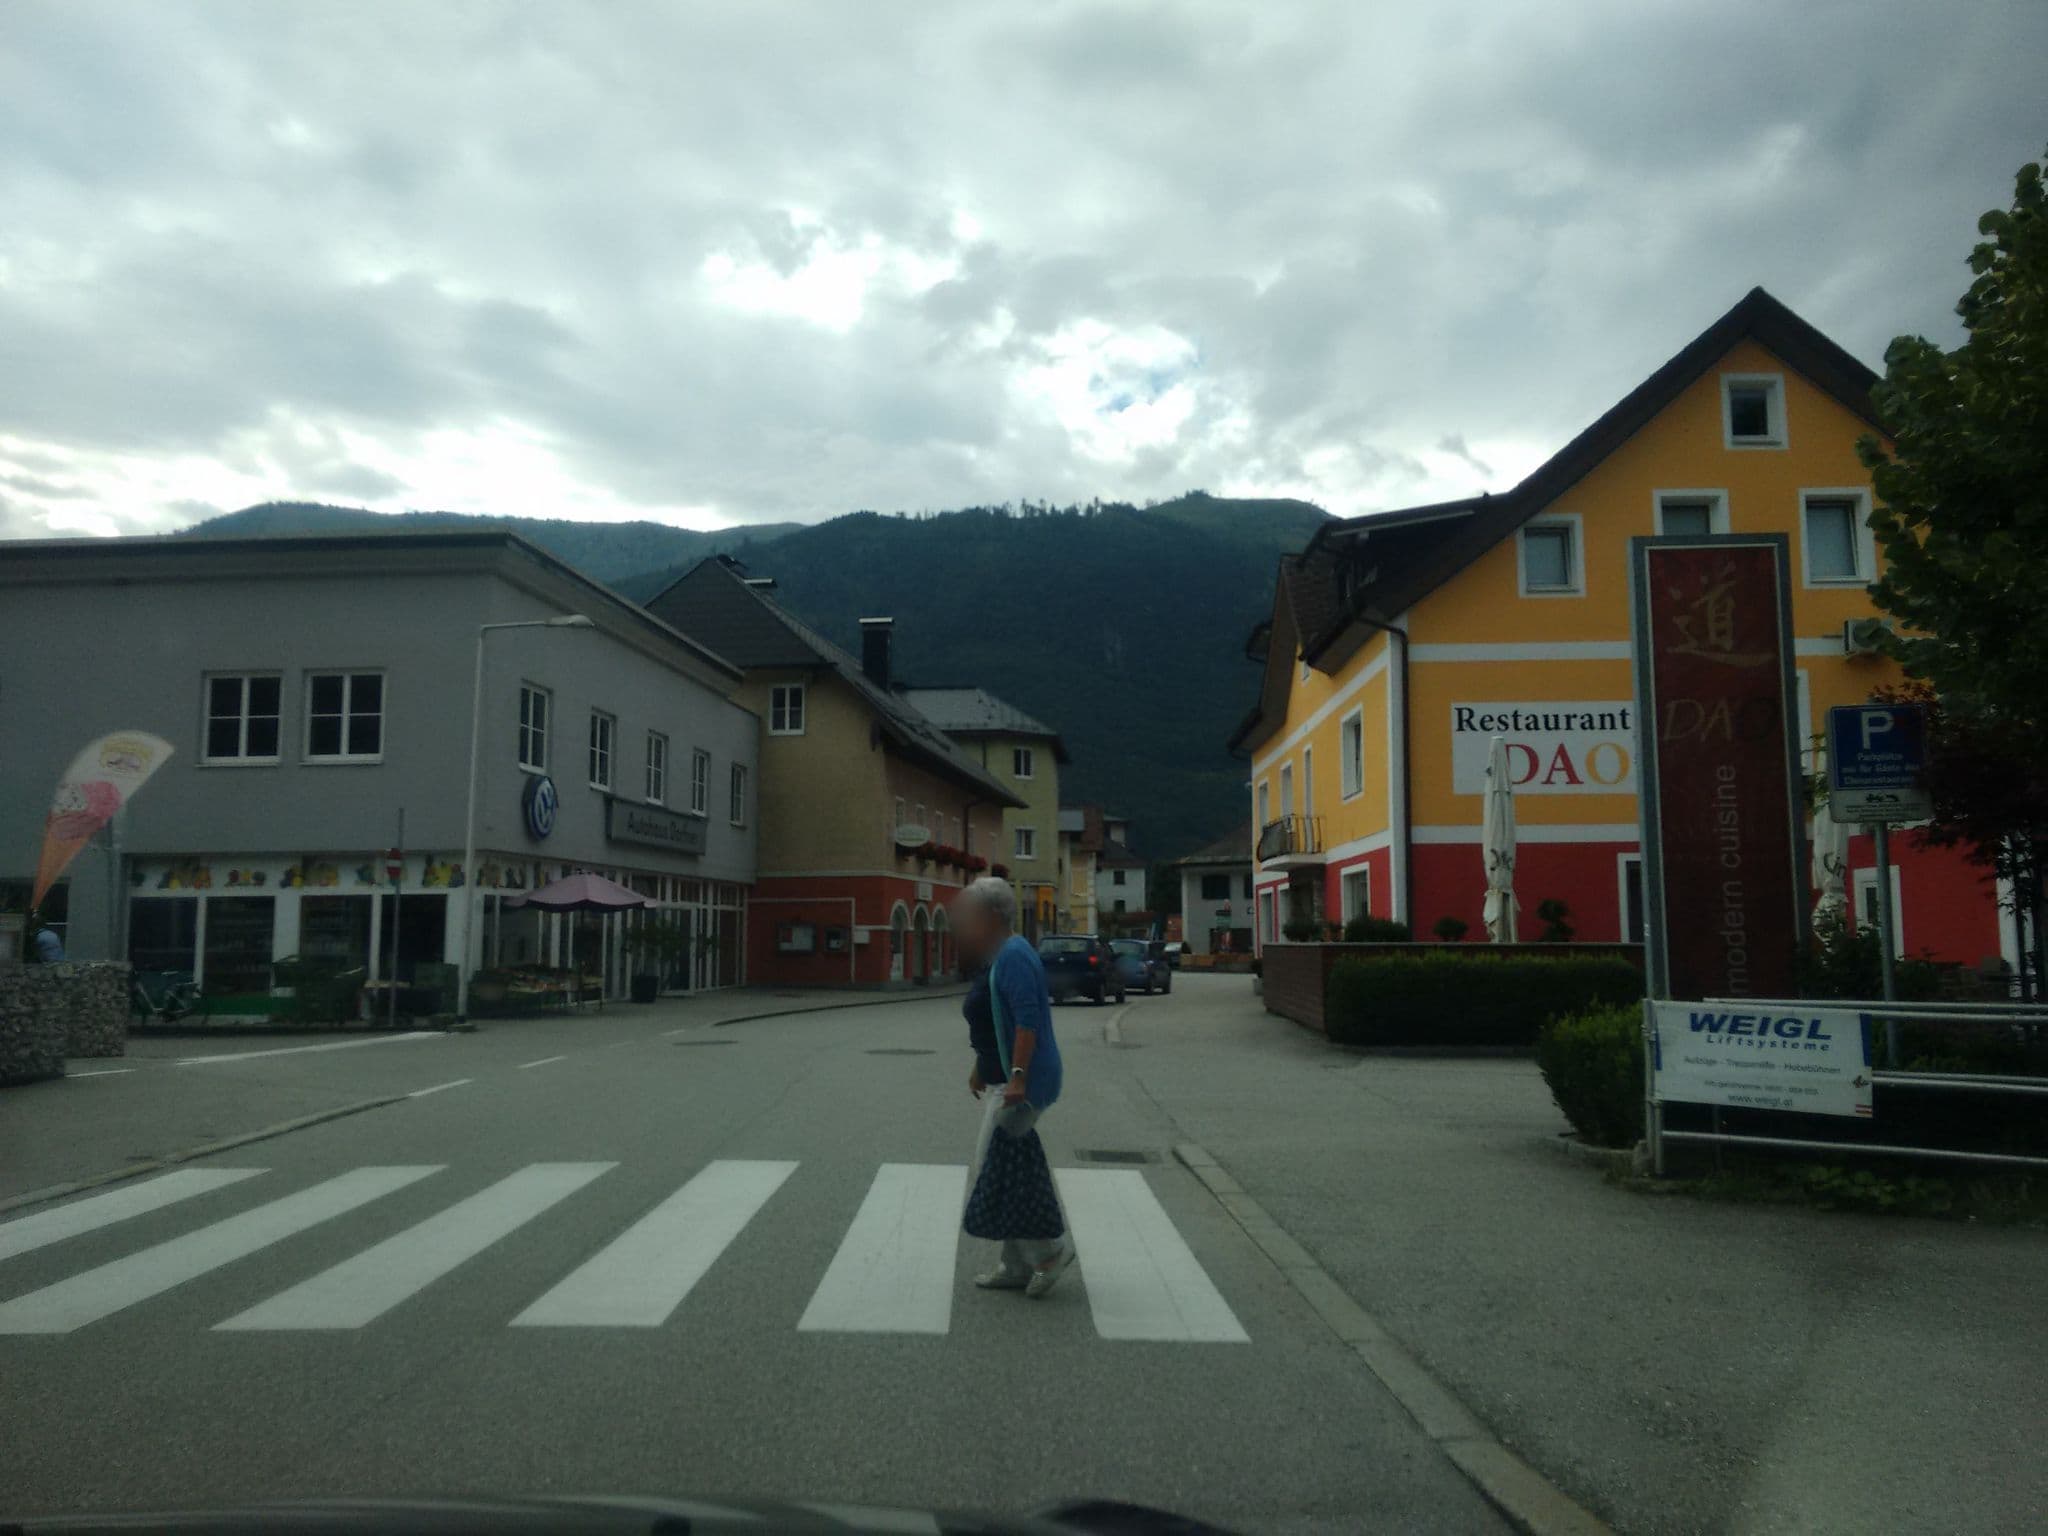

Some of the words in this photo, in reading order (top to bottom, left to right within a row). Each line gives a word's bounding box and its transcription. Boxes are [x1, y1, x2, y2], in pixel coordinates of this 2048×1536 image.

[1455, 708, 1631, 731] Restaurant
[1861, 710, 1896, 750] P
[1712, 764, 1743, 868] cuisine
[1719, 880, 1750, 994] modern
[1689, 1012, 1832, 1040] WEIGL
[1706, 1034, 1830, 1052] Liftsysteme
